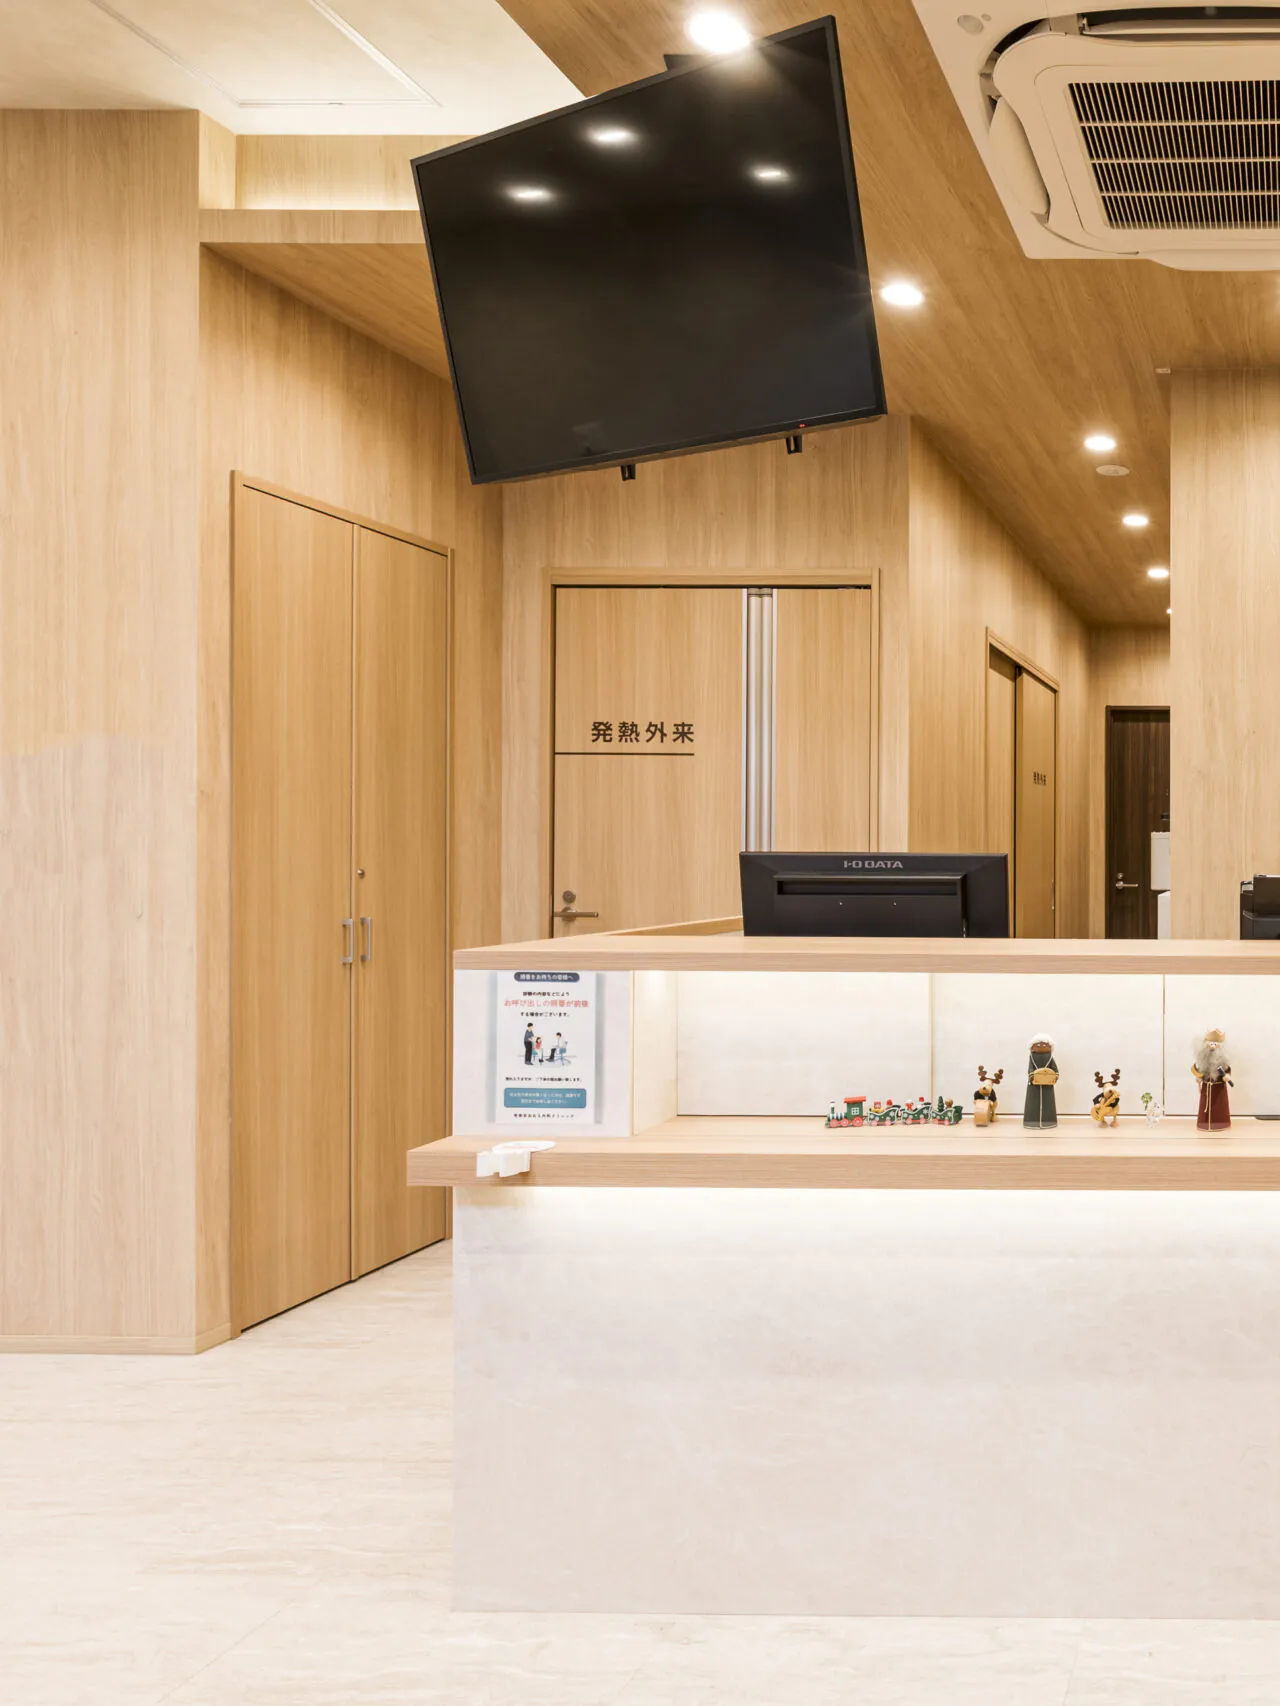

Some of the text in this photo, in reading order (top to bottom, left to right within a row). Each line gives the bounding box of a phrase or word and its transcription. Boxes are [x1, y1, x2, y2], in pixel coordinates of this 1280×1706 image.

[591, 720, 694, 744] 発熱外来
[864, 860, 904, 869] DATA
